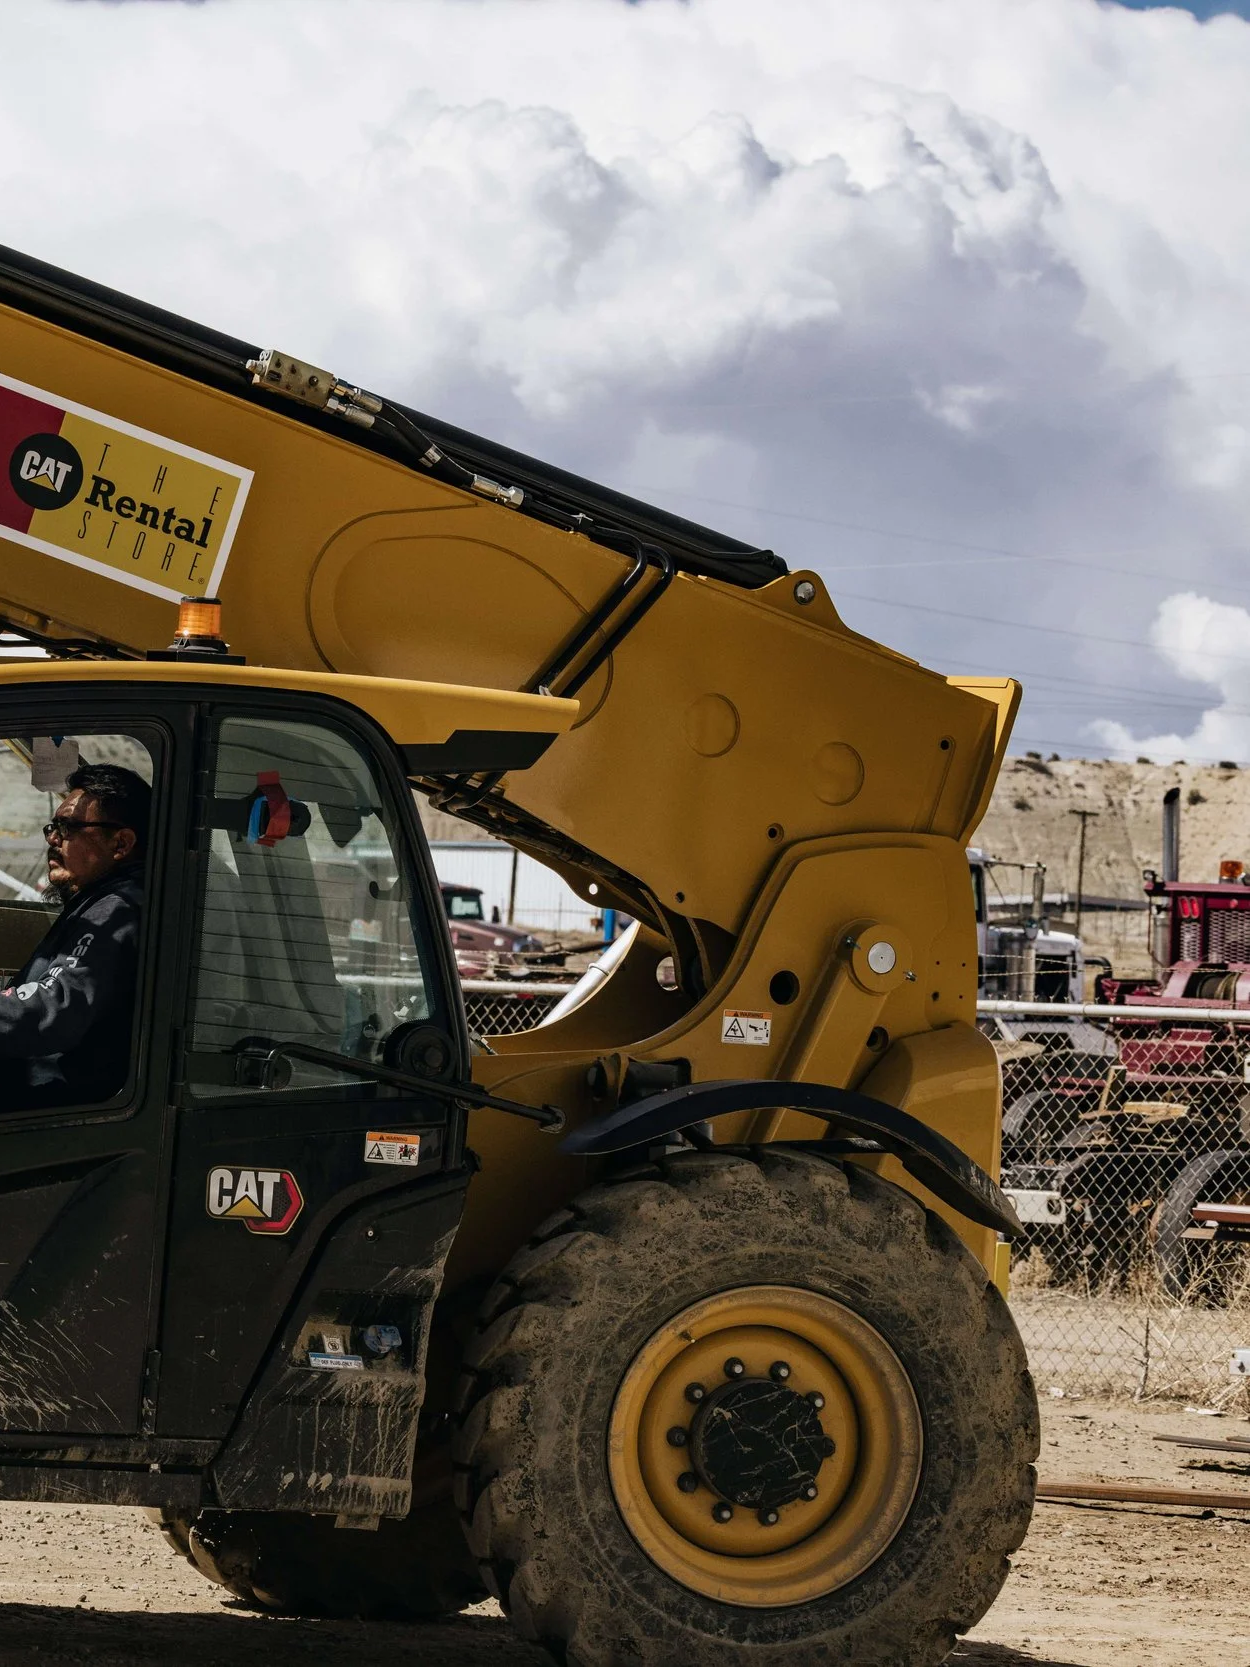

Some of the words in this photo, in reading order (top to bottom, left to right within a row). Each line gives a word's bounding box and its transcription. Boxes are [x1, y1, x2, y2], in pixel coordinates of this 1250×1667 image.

[19, 450, 73, 493] CAT
[98, 443, 222, 515] THE
[84, 474, 213, 548] Rental
[210, 1168, 280, 1218] CAT
